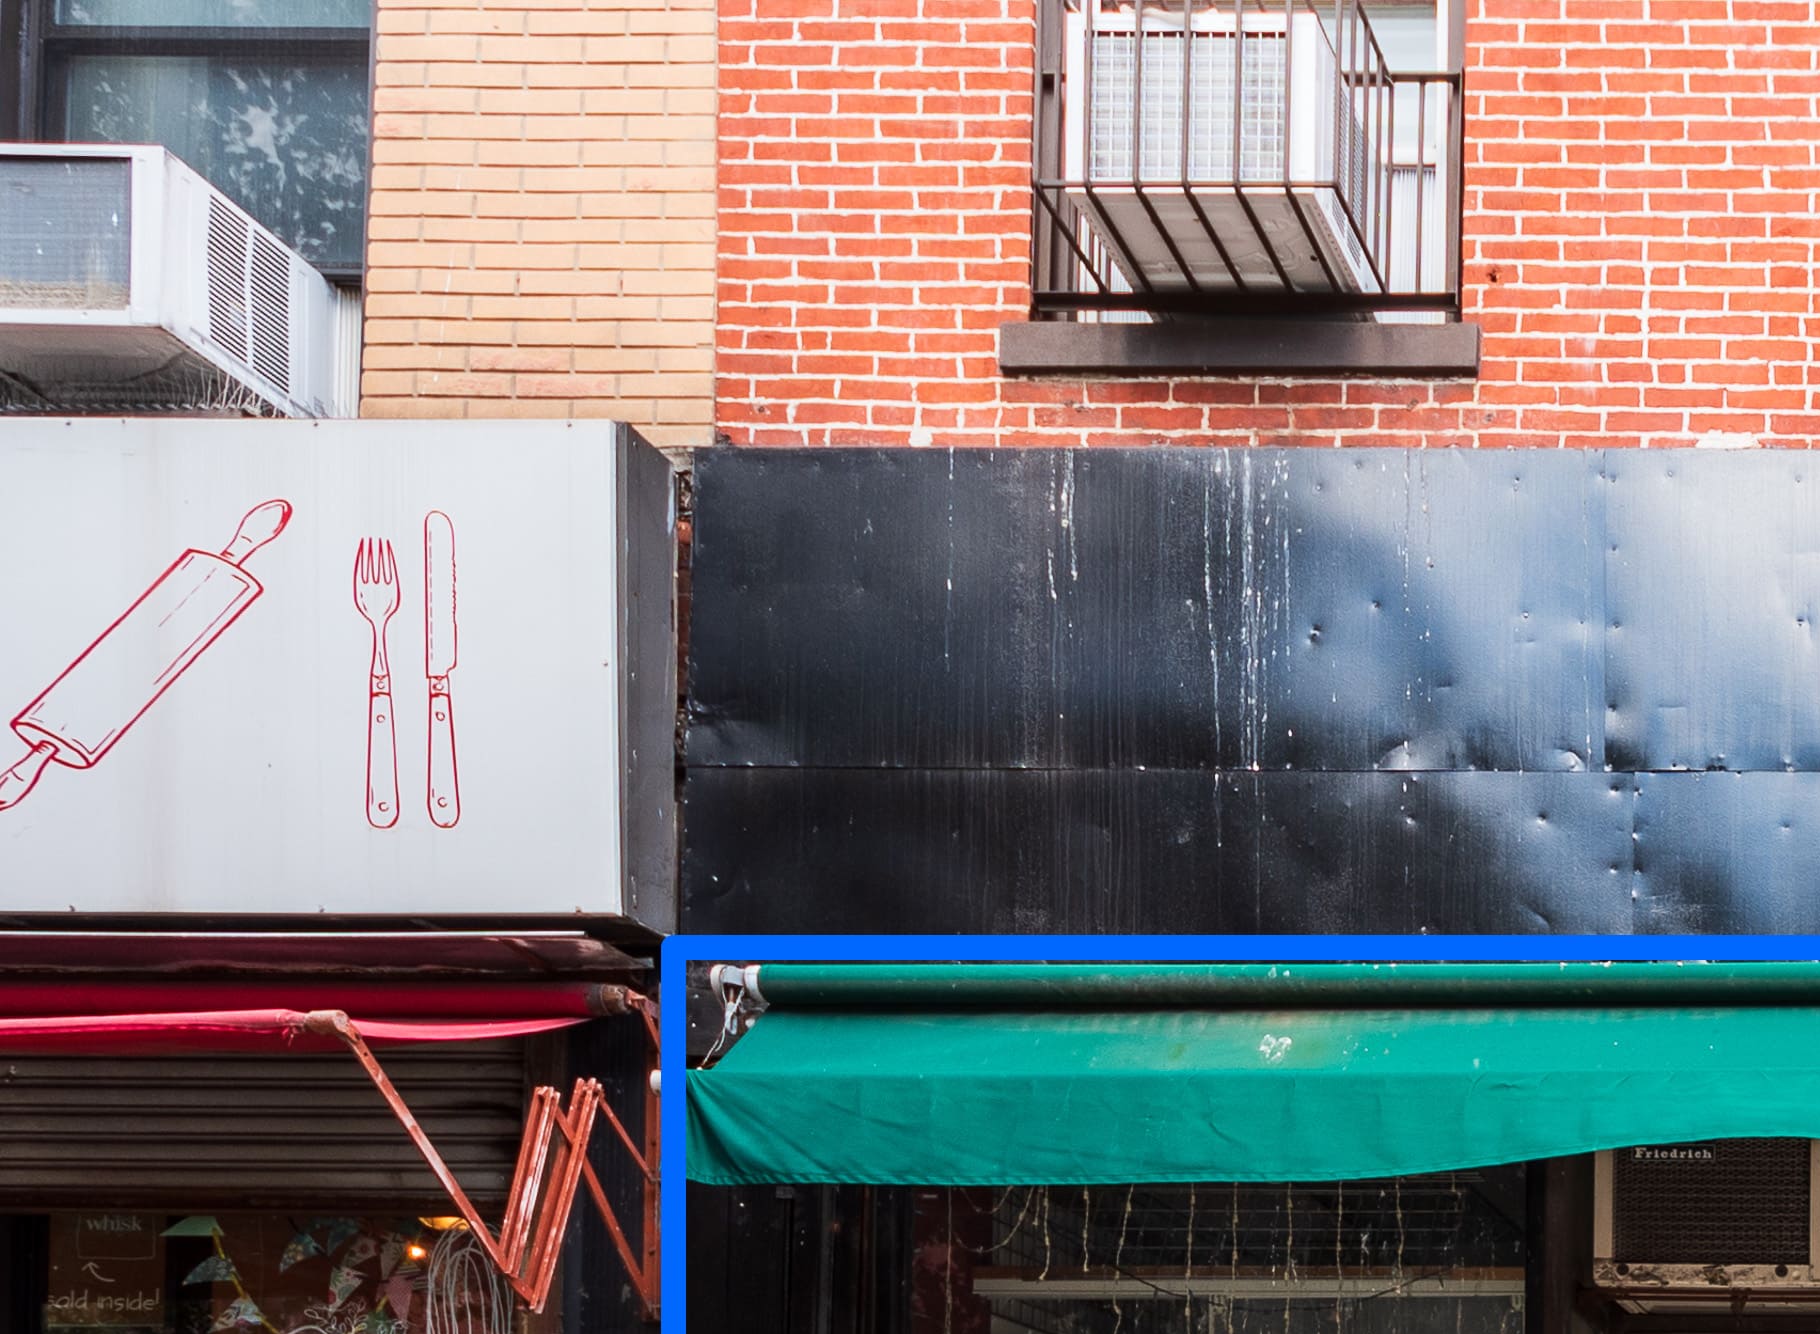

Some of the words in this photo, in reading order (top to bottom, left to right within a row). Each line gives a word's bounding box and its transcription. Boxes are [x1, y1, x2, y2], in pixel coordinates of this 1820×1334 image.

[1634, 1147, 1712, 1158] Friedrich
[86, 1215, 142, 1231] whisk
[97, 1288, 160, 1311] inside!
